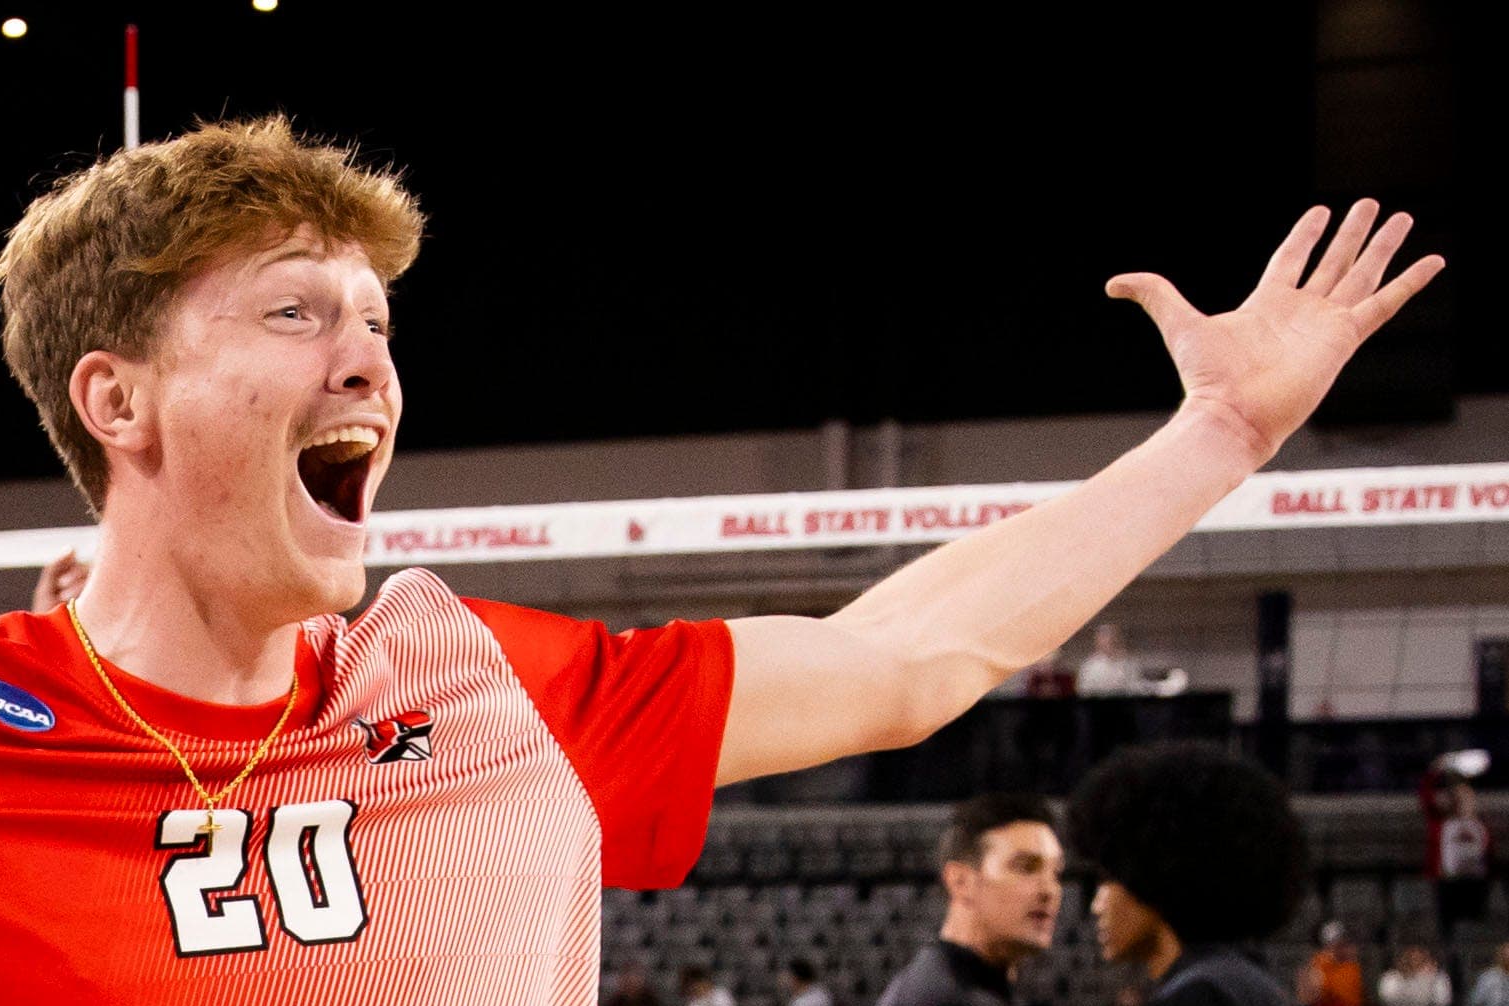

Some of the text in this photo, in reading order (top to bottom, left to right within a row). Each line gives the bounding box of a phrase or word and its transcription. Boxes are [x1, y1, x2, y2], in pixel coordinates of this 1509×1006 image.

[1270, 489, 1345, 514] BALL
[1361, 484, 1457, 513] STATE
[721, 512, 790, 537] BALL
[804, 508, 891, 534] STATE
[383, 523, 552, 553] VOLLEYBALL
[154, 799, 369, 958] 20
